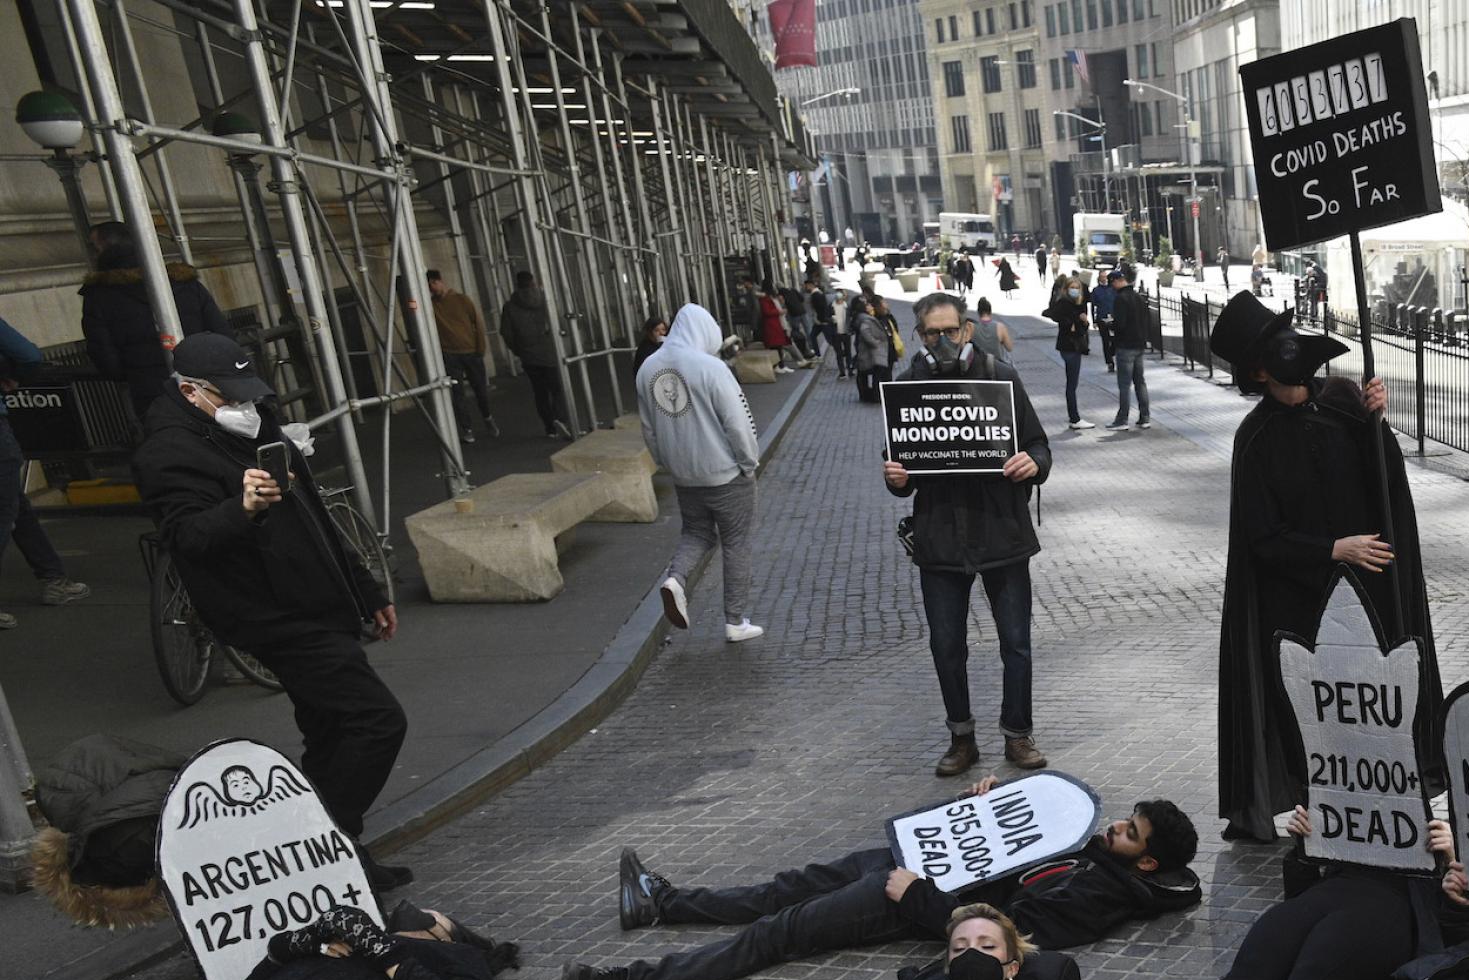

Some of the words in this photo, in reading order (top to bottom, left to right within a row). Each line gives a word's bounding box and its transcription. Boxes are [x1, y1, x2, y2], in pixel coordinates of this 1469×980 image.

[1271, 141, 1327, 177] COVID
[1333, 112, 1406, 158] DEATHS
[892, 426, 1011, 442] MONOPOLIES
[900, 407, 936, 422] END
[940, 406, 998, 421] COVID
[899, 452, 917, 460] HELP
[918, 451, 960, 459] VACCINATE
[962, 450, 976, 458] THE
[978, 449, 1008, 458] WORLD
[1311, 680, 1403, 728] PERU
[1311, 752, 1419, 794] 211,000+
[946, 803, 993, 879] 515,000+
[989, 790, 1043, 856] INDIA
[1319, 803, 1418, 850] DEAD
[182, 830, 353, 906] ARGENTINA
[913, 827, 951, 877] DEAD
